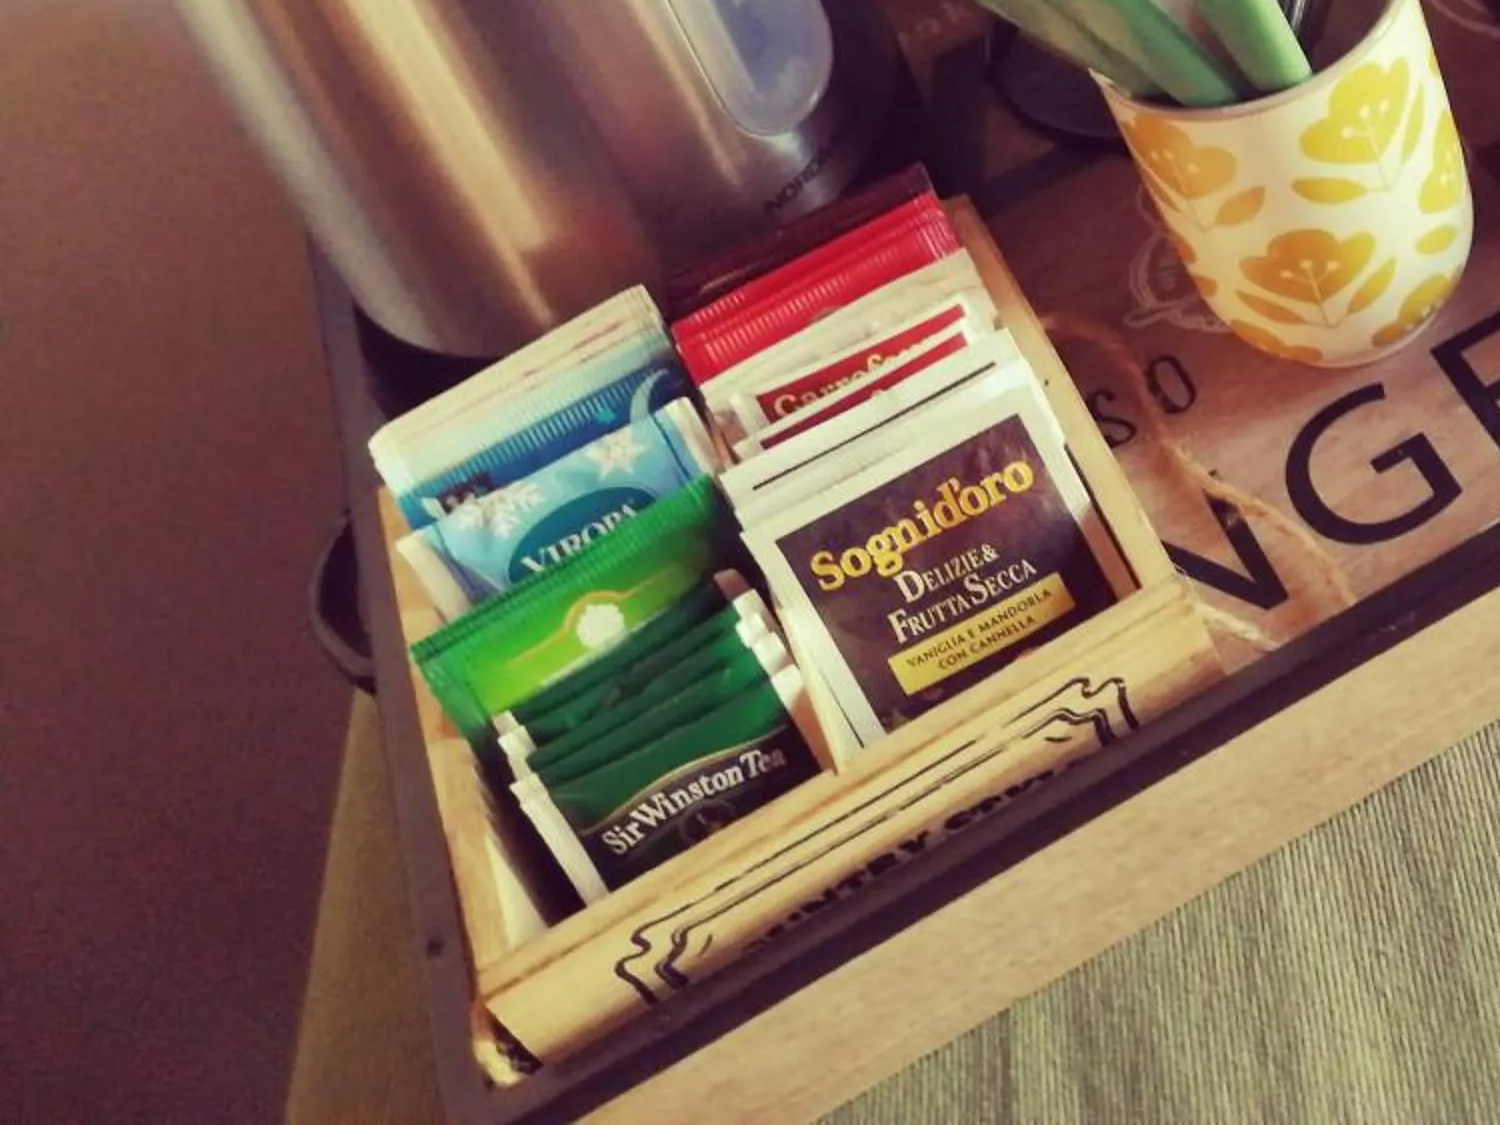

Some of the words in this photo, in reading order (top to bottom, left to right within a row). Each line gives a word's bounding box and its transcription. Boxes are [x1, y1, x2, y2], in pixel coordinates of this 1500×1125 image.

[887, 598, 971, 644] FRUTTA
[963, 559, 1038, 606] SECCA
[906, 632, 967, 668] VANIGLIA
[978, 588, 1052, 638] MANDORLA
[937, 650, 968, 671] CON
[970, 615, 1037, 655] CANNELLA
